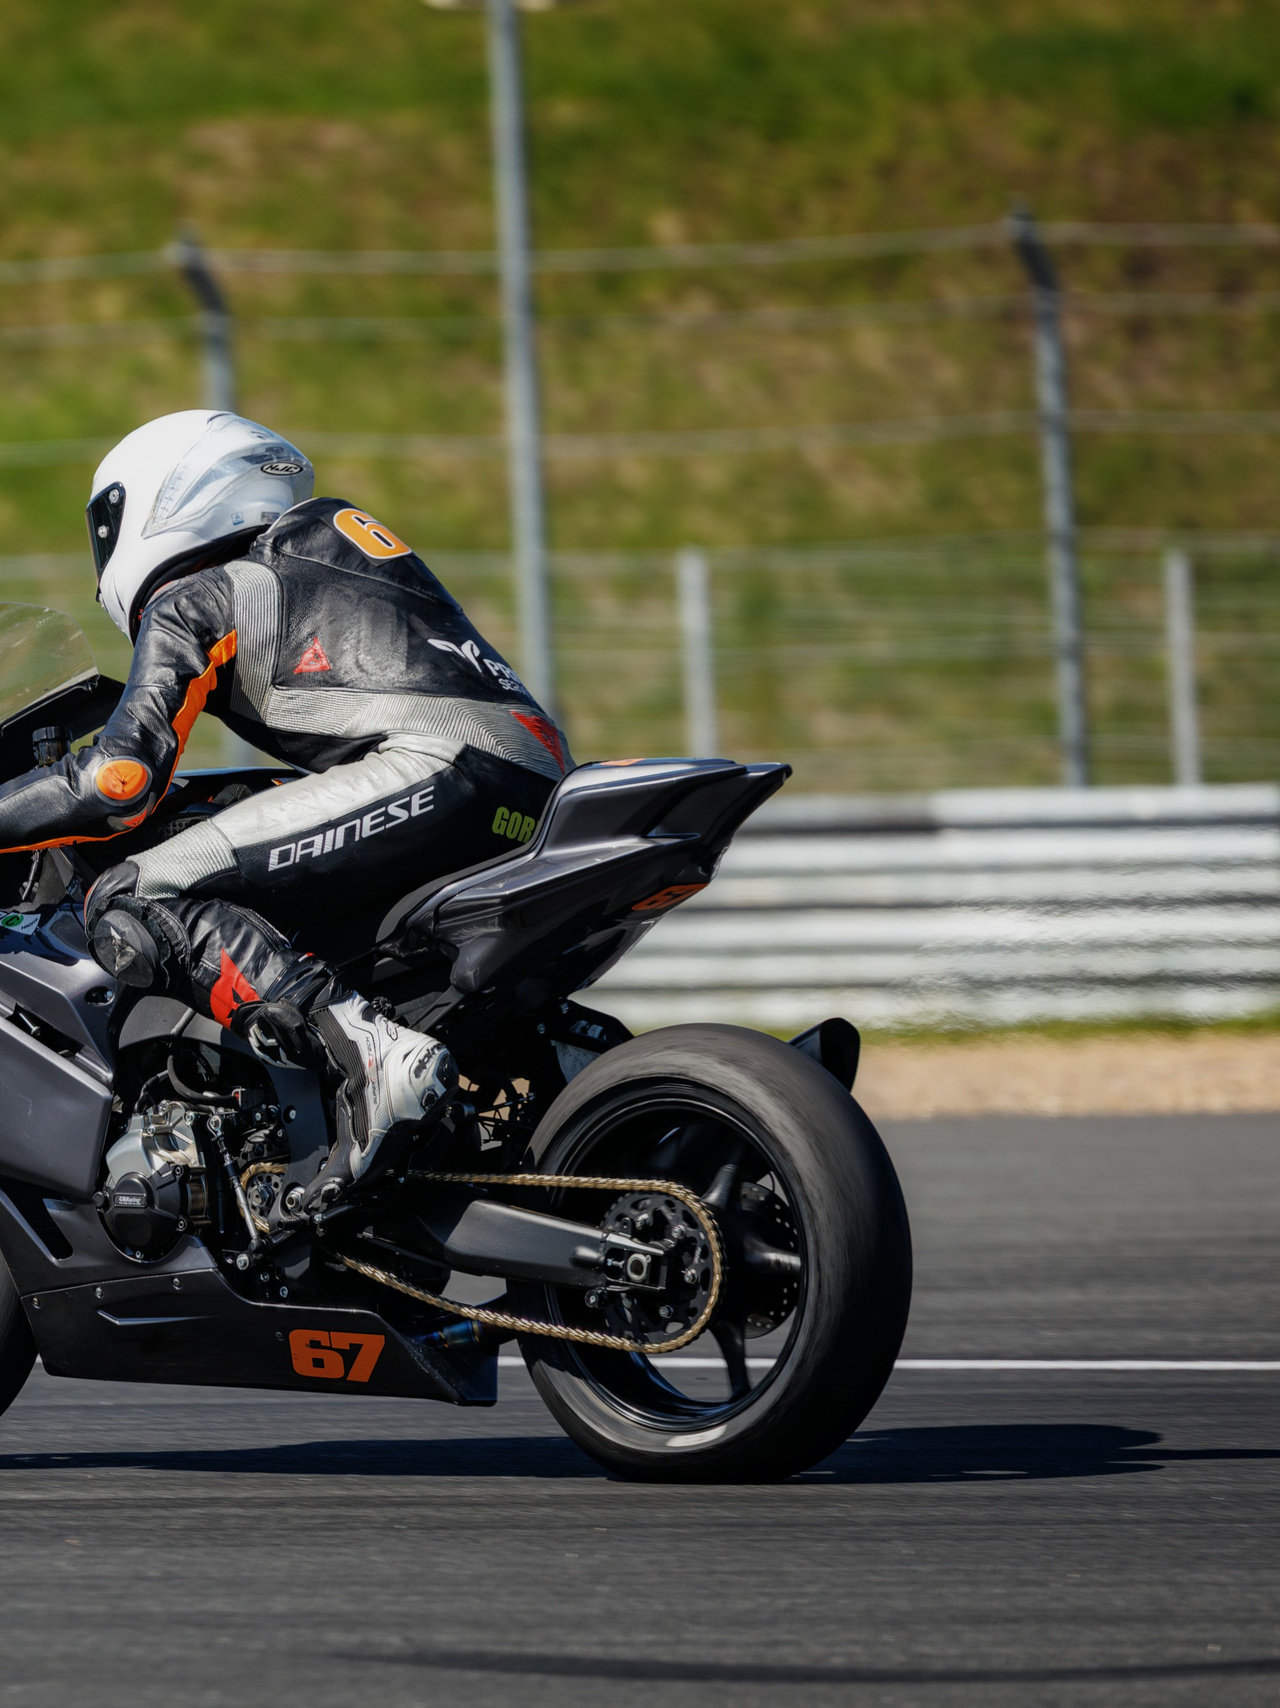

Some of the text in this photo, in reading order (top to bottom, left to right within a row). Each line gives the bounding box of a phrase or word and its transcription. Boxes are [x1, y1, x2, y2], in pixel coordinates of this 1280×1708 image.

[265, 464, 298, 473] HJC
[268, 785, 435, 872] DAINESE
[289, 1329, 386, 1382] 67
